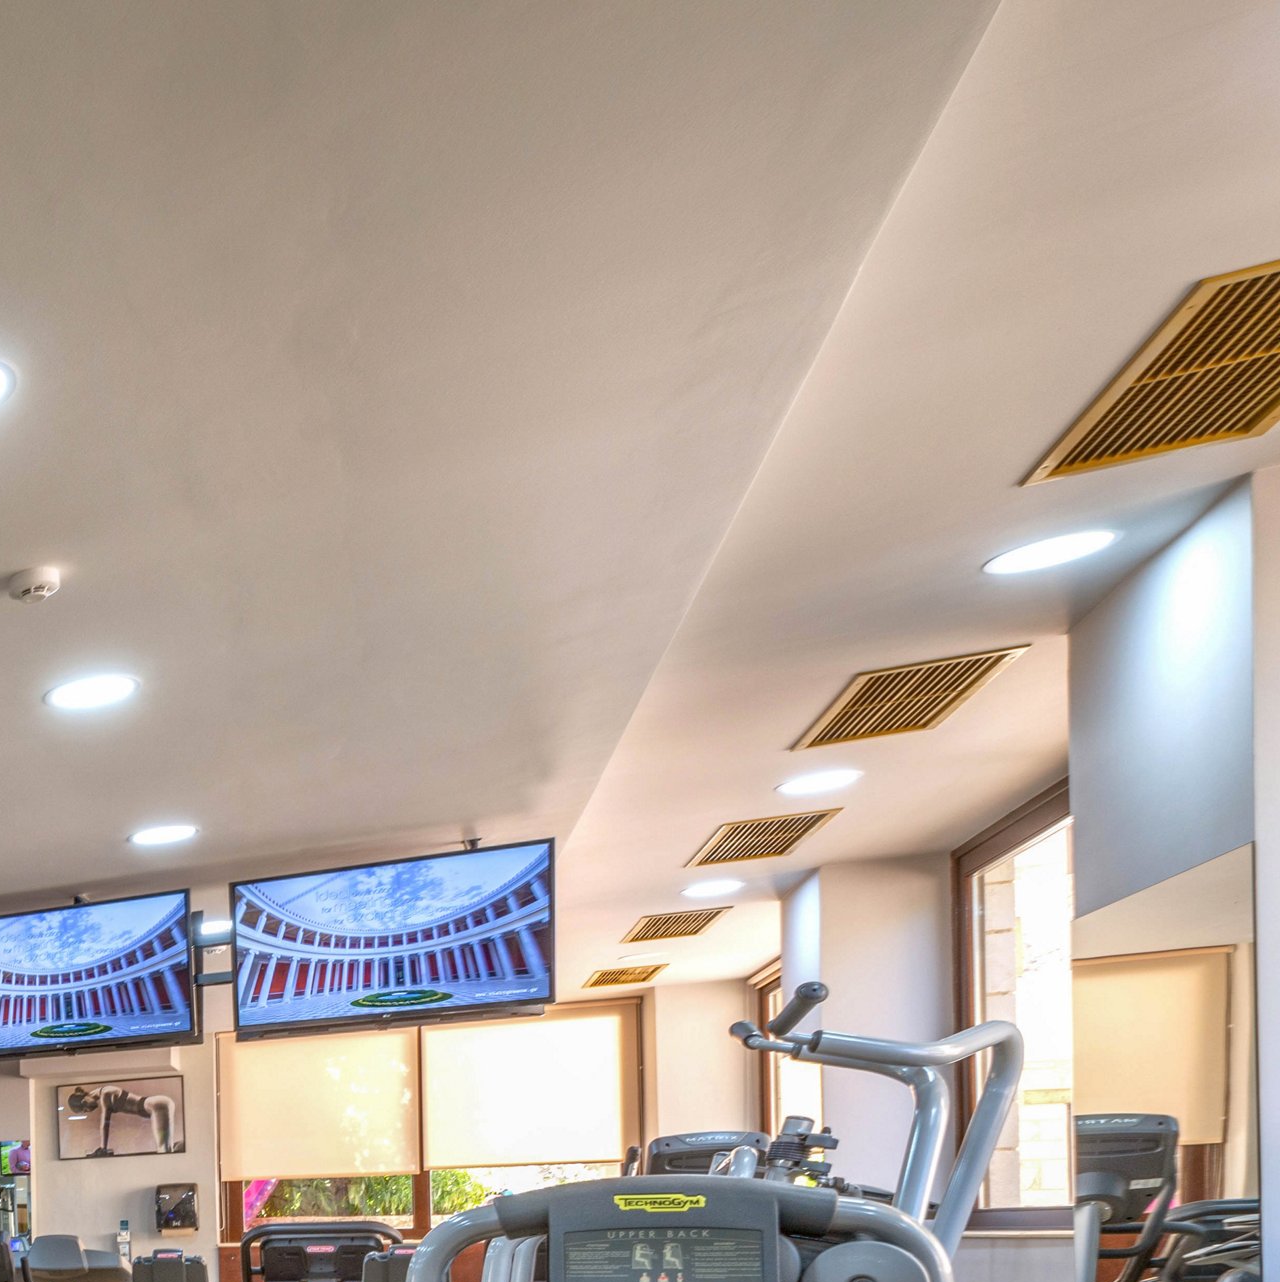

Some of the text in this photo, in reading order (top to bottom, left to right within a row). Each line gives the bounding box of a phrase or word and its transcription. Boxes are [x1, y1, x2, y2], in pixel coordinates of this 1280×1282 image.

[685, 1135, 738, 1143] MATRIX
[607, 1230, 710, 1239] UPPER BACK
